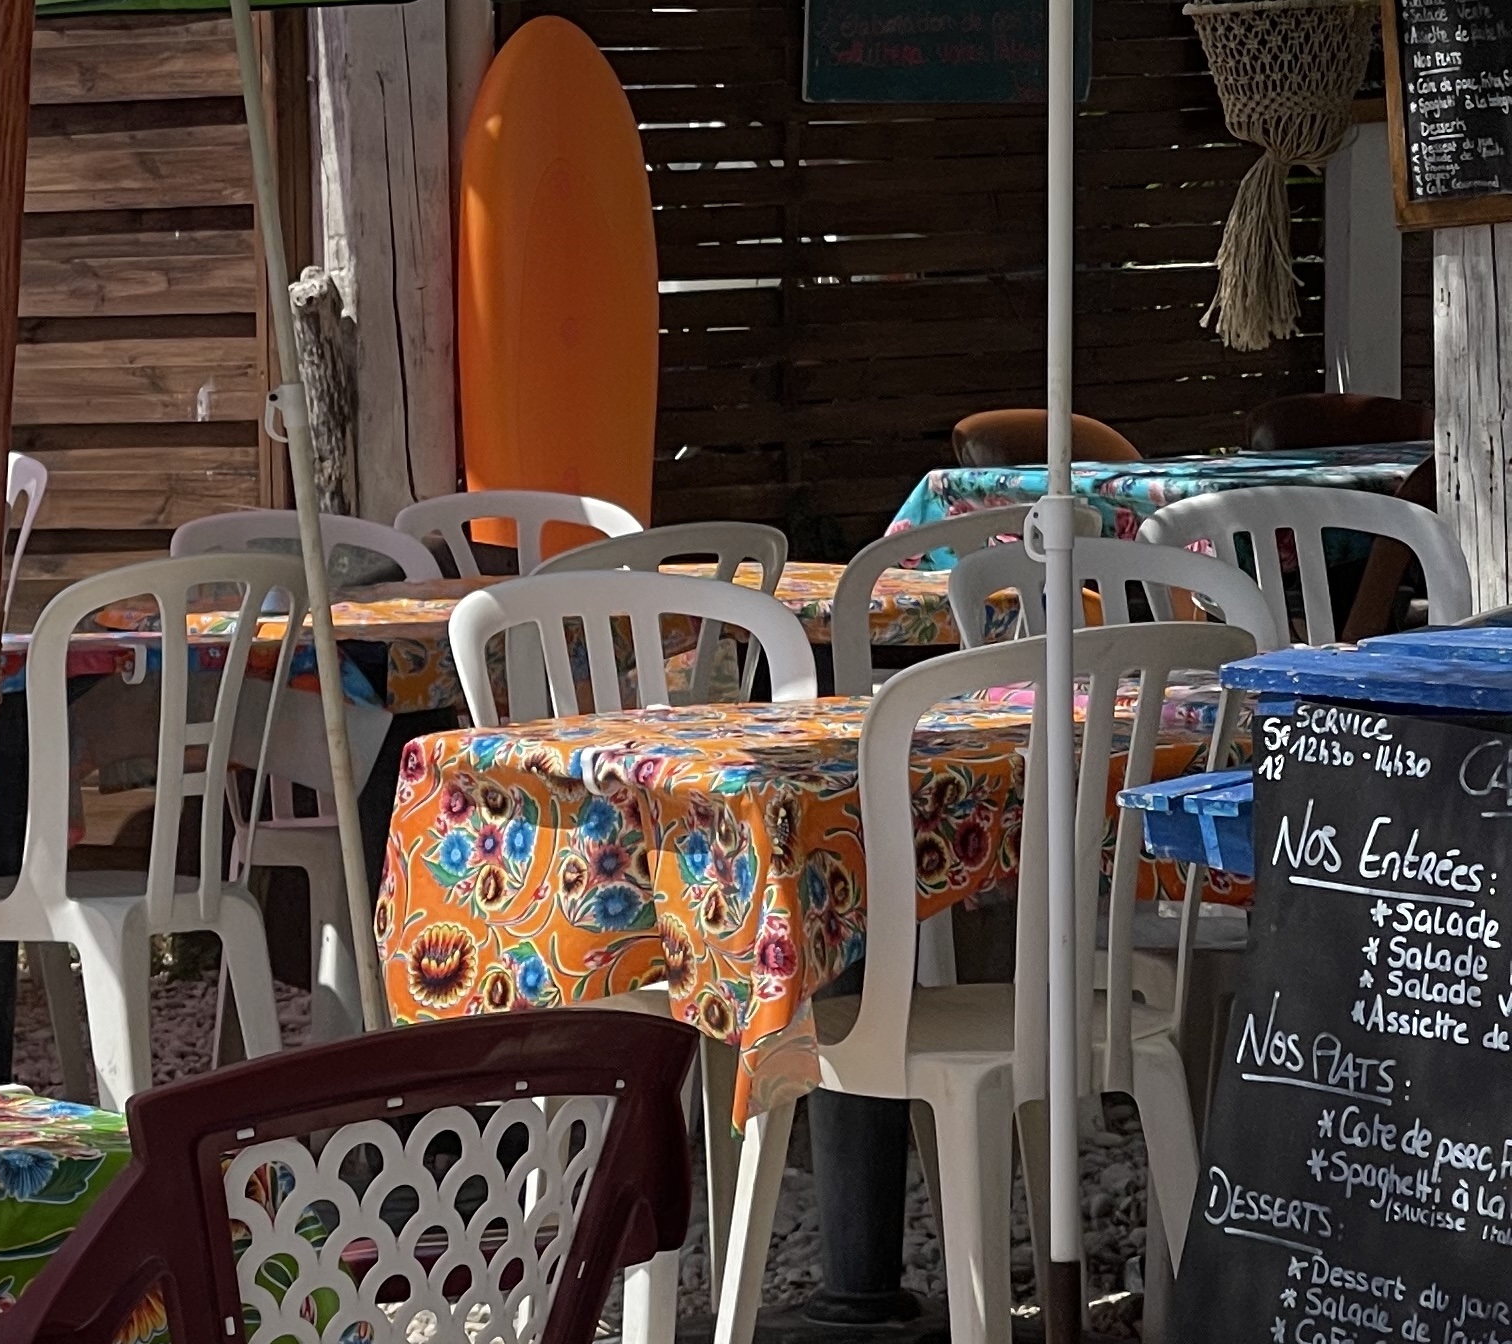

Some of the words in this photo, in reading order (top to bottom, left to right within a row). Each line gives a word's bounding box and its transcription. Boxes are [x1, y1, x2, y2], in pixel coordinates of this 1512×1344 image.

[1258, 754, 1285, 781] 12
[1289, 734, 1355, 767] 12h30
[1375, 744, 1432, 778] 14h30
[1272, 798, 1343, 873] Nos
[1392, 902, 1502, 949] Salade
[1387, 935, 1489, 982] Salade
[1386, 970, 1483, 1008] Salade
[1236, 990, 1305, 1072] Nos
[1482, 1023, 1511, 1051] de
[1400, 1117, 1433, 1159] de
[1330, 1150, 1441, 1209] Spaghetti
[1451, 1178, 1470, 1212] à
[1311, 1255, 1406, 1301] Dessert
[1419, 1282, 1449, 1311] du
[1304, 1287, 1393, 1333] Salade
[1401, 1312, 1431, 1343] de
